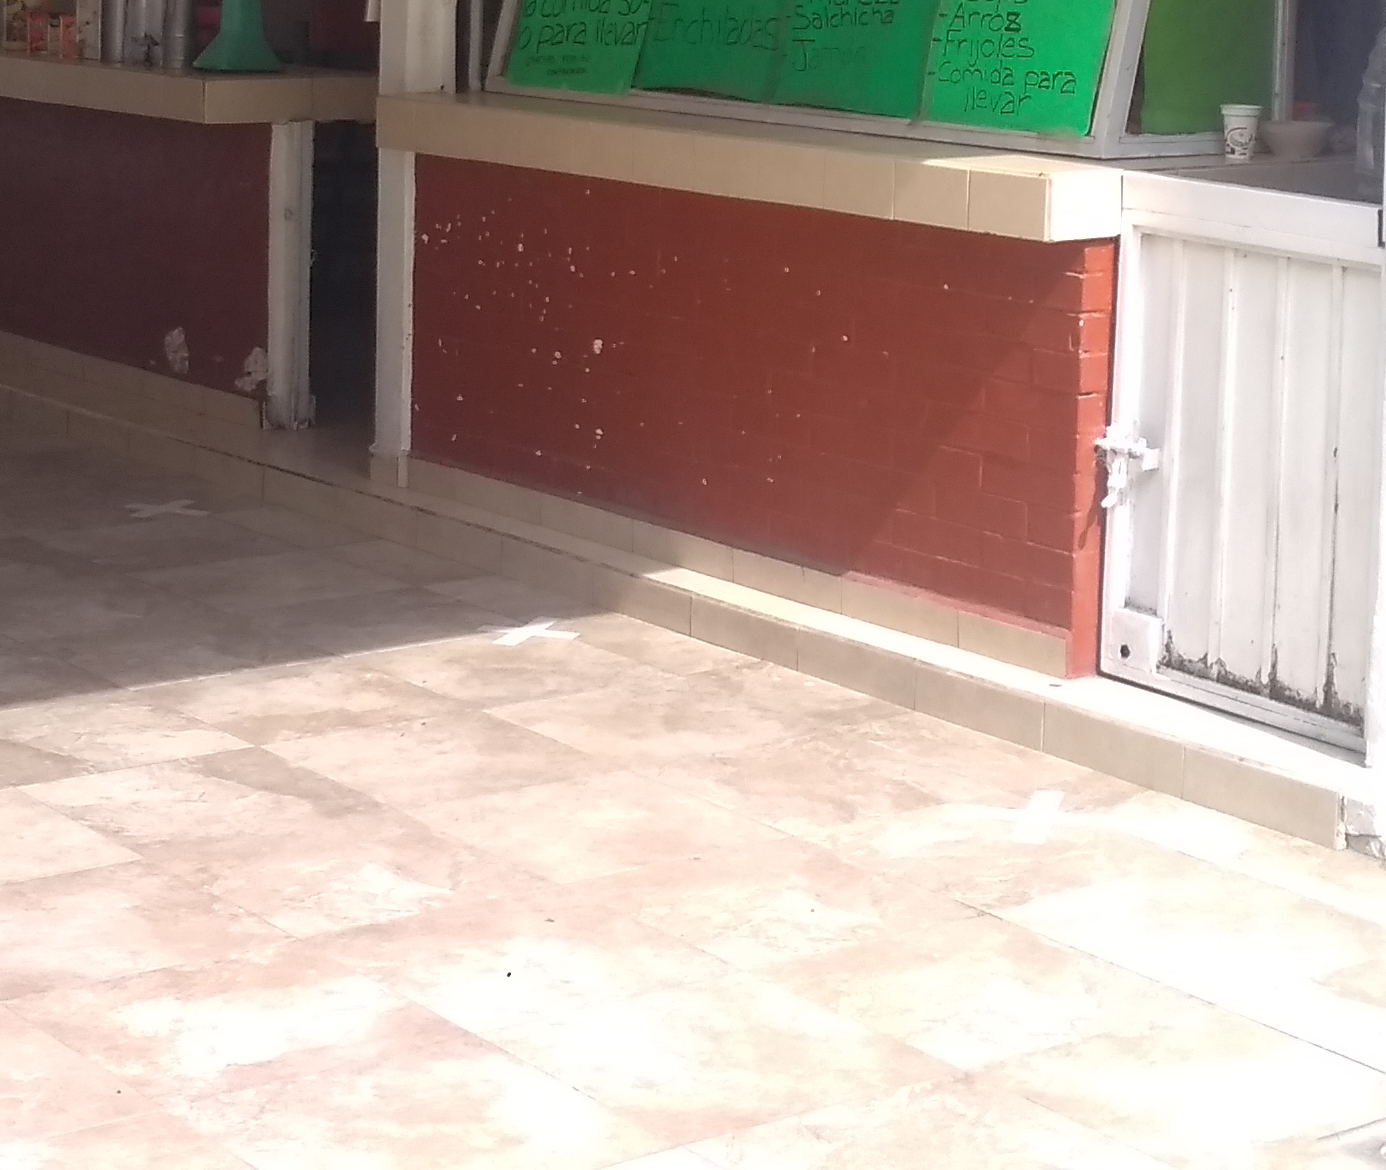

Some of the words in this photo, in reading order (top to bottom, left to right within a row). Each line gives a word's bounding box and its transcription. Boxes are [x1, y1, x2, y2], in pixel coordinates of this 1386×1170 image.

[537, 22, 587, 54] para
[597, 17, 649, 46] llevar
[1024, 70, 1077, 94] para
[964, 87, 1032, 115] llevar
